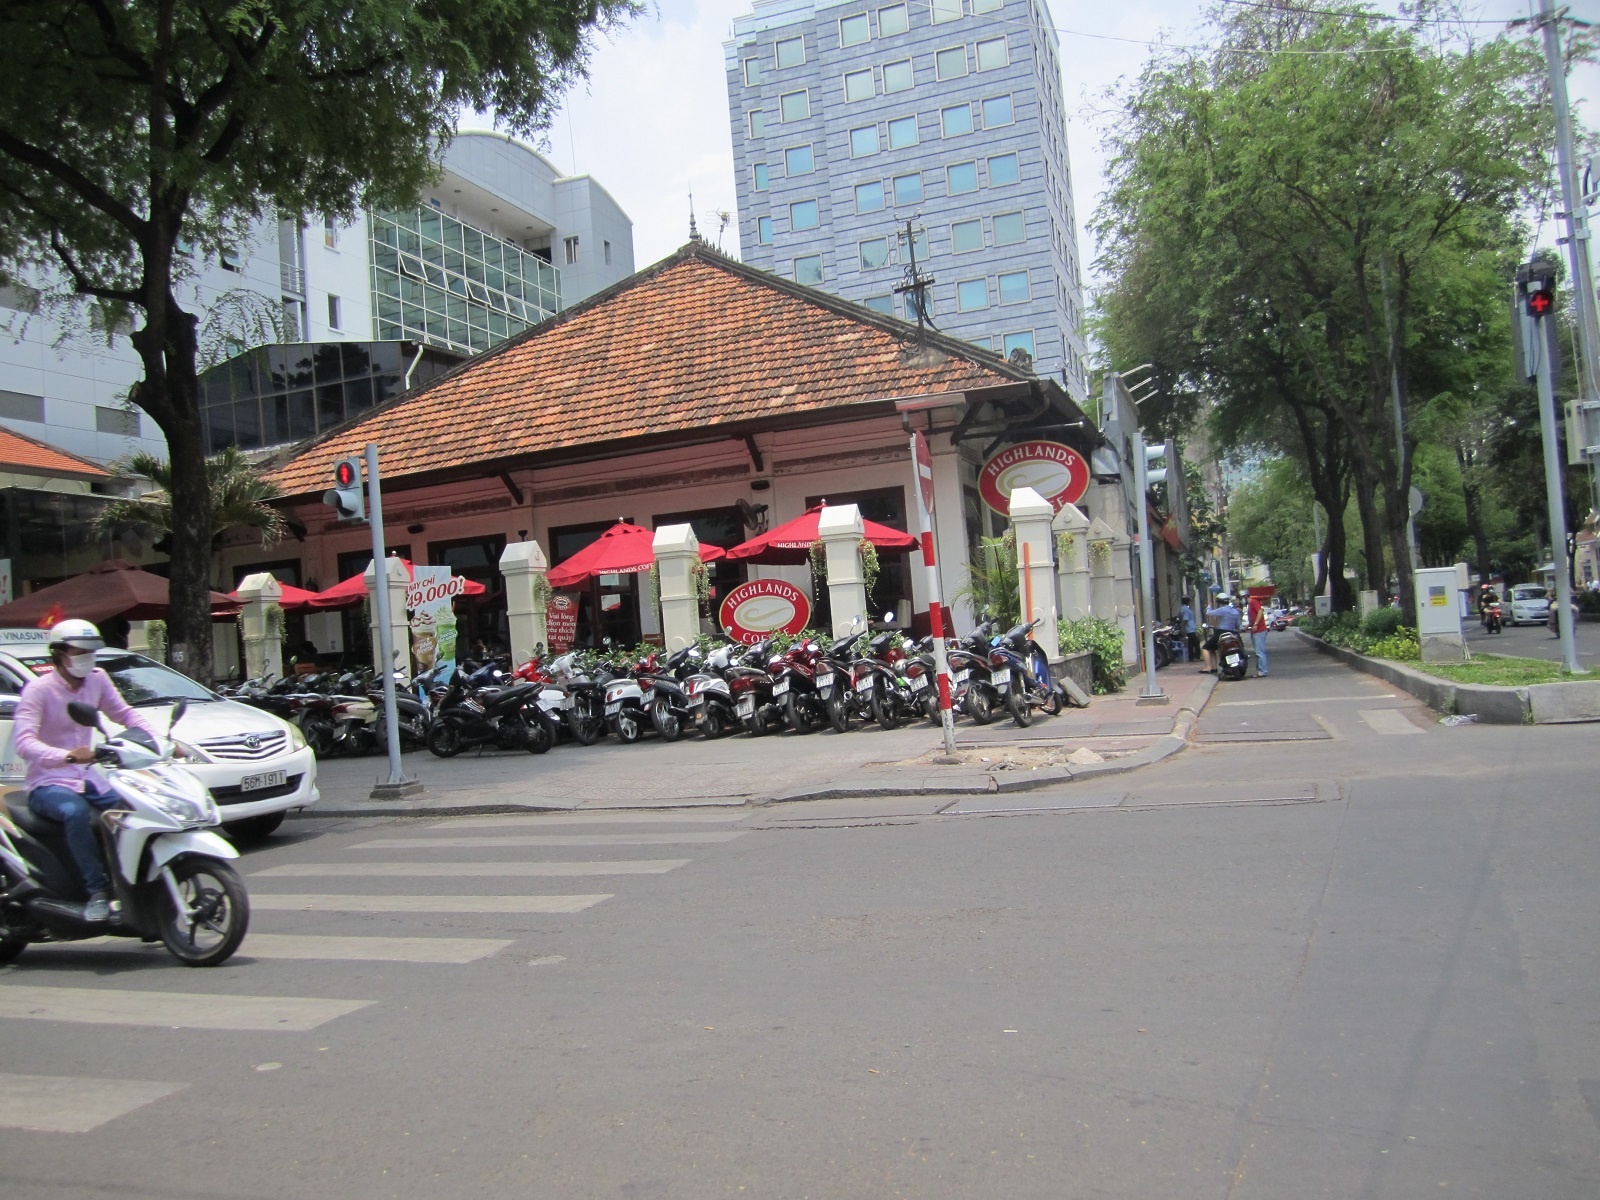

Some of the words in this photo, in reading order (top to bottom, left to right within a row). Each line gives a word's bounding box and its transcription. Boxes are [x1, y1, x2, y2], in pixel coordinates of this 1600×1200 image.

[987, 445, 1075, 476] HIGHLANDS
[407, 578, 463, 608] 49.000!
[727, 583, 799, 609] HIGHLANDS
[244, 773, 283, 789] 56M-1911
